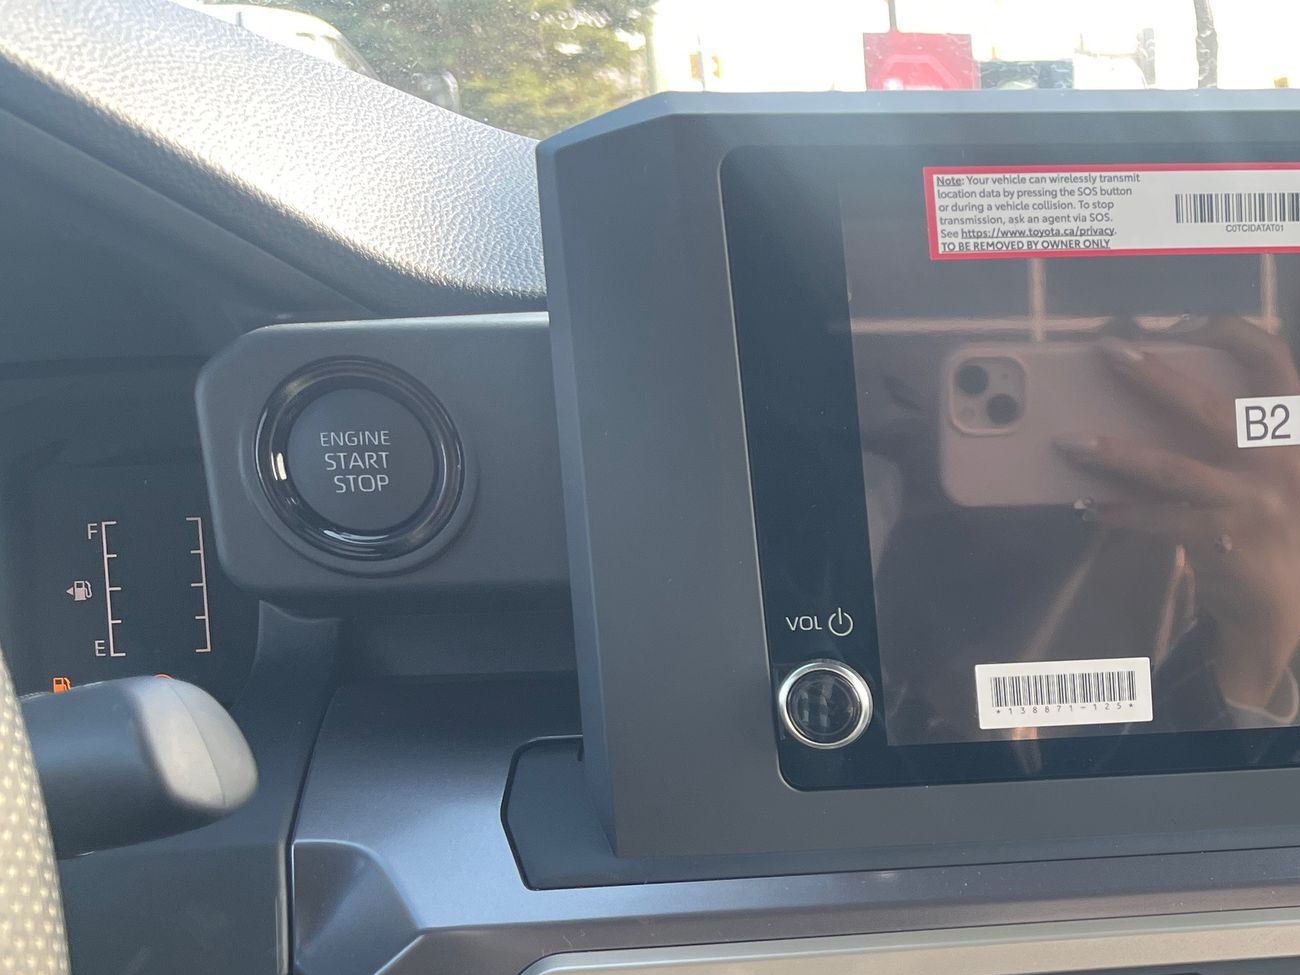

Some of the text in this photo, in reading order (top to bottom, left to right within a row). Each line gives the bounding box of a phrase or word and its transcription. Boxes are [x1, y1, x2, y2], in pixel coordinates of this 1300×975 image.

[937, 173, 1141, 186] Note: Your vehicle can wirelessly transmit
[937, 187, 1132, 199] location data by pressing the SOS button
[939, 204, 949, 212] or
[951, 203, 984, 213] during
[995, 201, 1030, 211] vehicle
[1032, 201, 1076, 210] collision.
[1078, 200, 1090, 209] To
[1092, 201, 1114, 210] stop
[940, 215, 1006, 225] transmission,
[1008, 214, 1025, 224] ask
[1042, 214, 1071, 225] agent
[1073, 214, 1087, 222] via
[1090, 213, 1112, 222] SOS.
[941, 227, 1117, 239] See https://www.toyota.ca/privacy.
[941, 239, 1111, 252] TO BE REMOVED BY OWNER ONLY
[1245, 404, 1291, 441] B2
[320, 431, 391, 446] ENGINE
[325, 452, 389, 470] START
[334, 474, 389, 493] STOP
[88, 523, 97, 539] F
[786, 616, 822, 630] VOL
[95, 640, 106, 656] E
